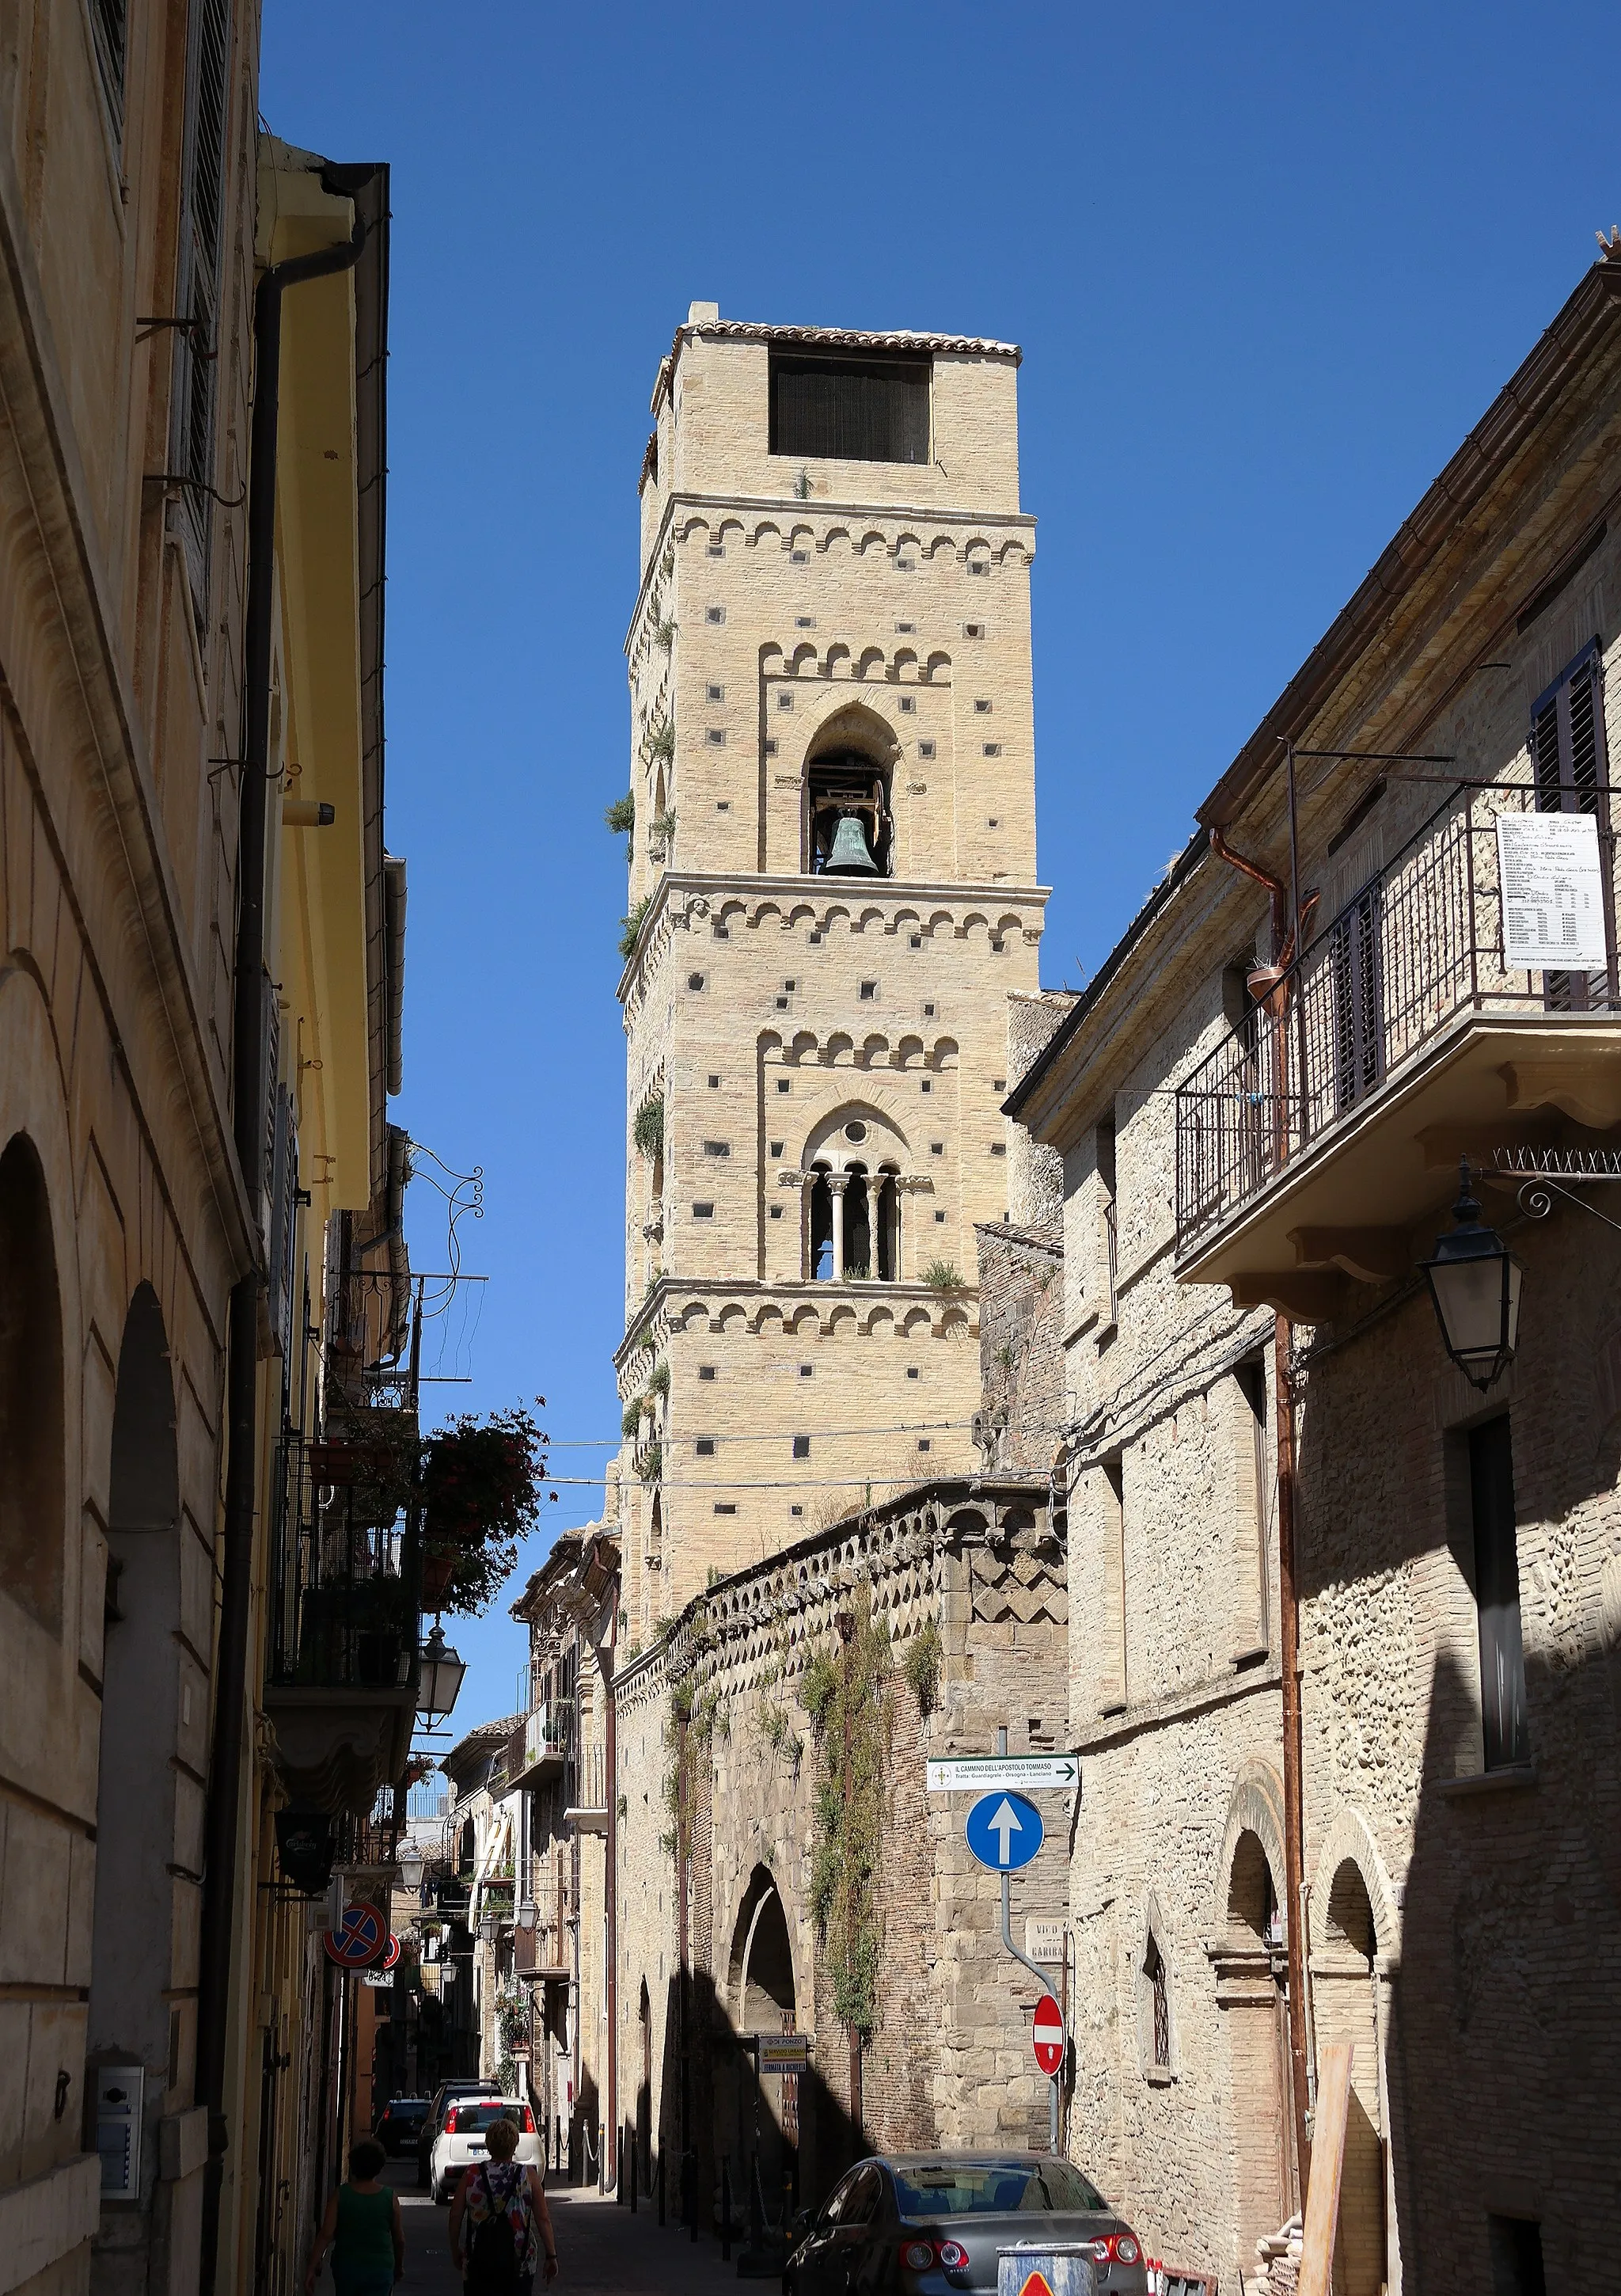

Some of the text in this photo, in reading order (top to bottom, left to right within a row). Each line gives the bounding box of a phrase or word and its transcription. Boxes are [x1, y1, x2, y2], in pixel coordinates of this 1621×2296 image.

[985, 1763, 1026, 1772] DELL'APOSTOLO
[1037, 1925, 1057, 1934] VICO
[1032, 1947, 1063, 1956] GARIBA
